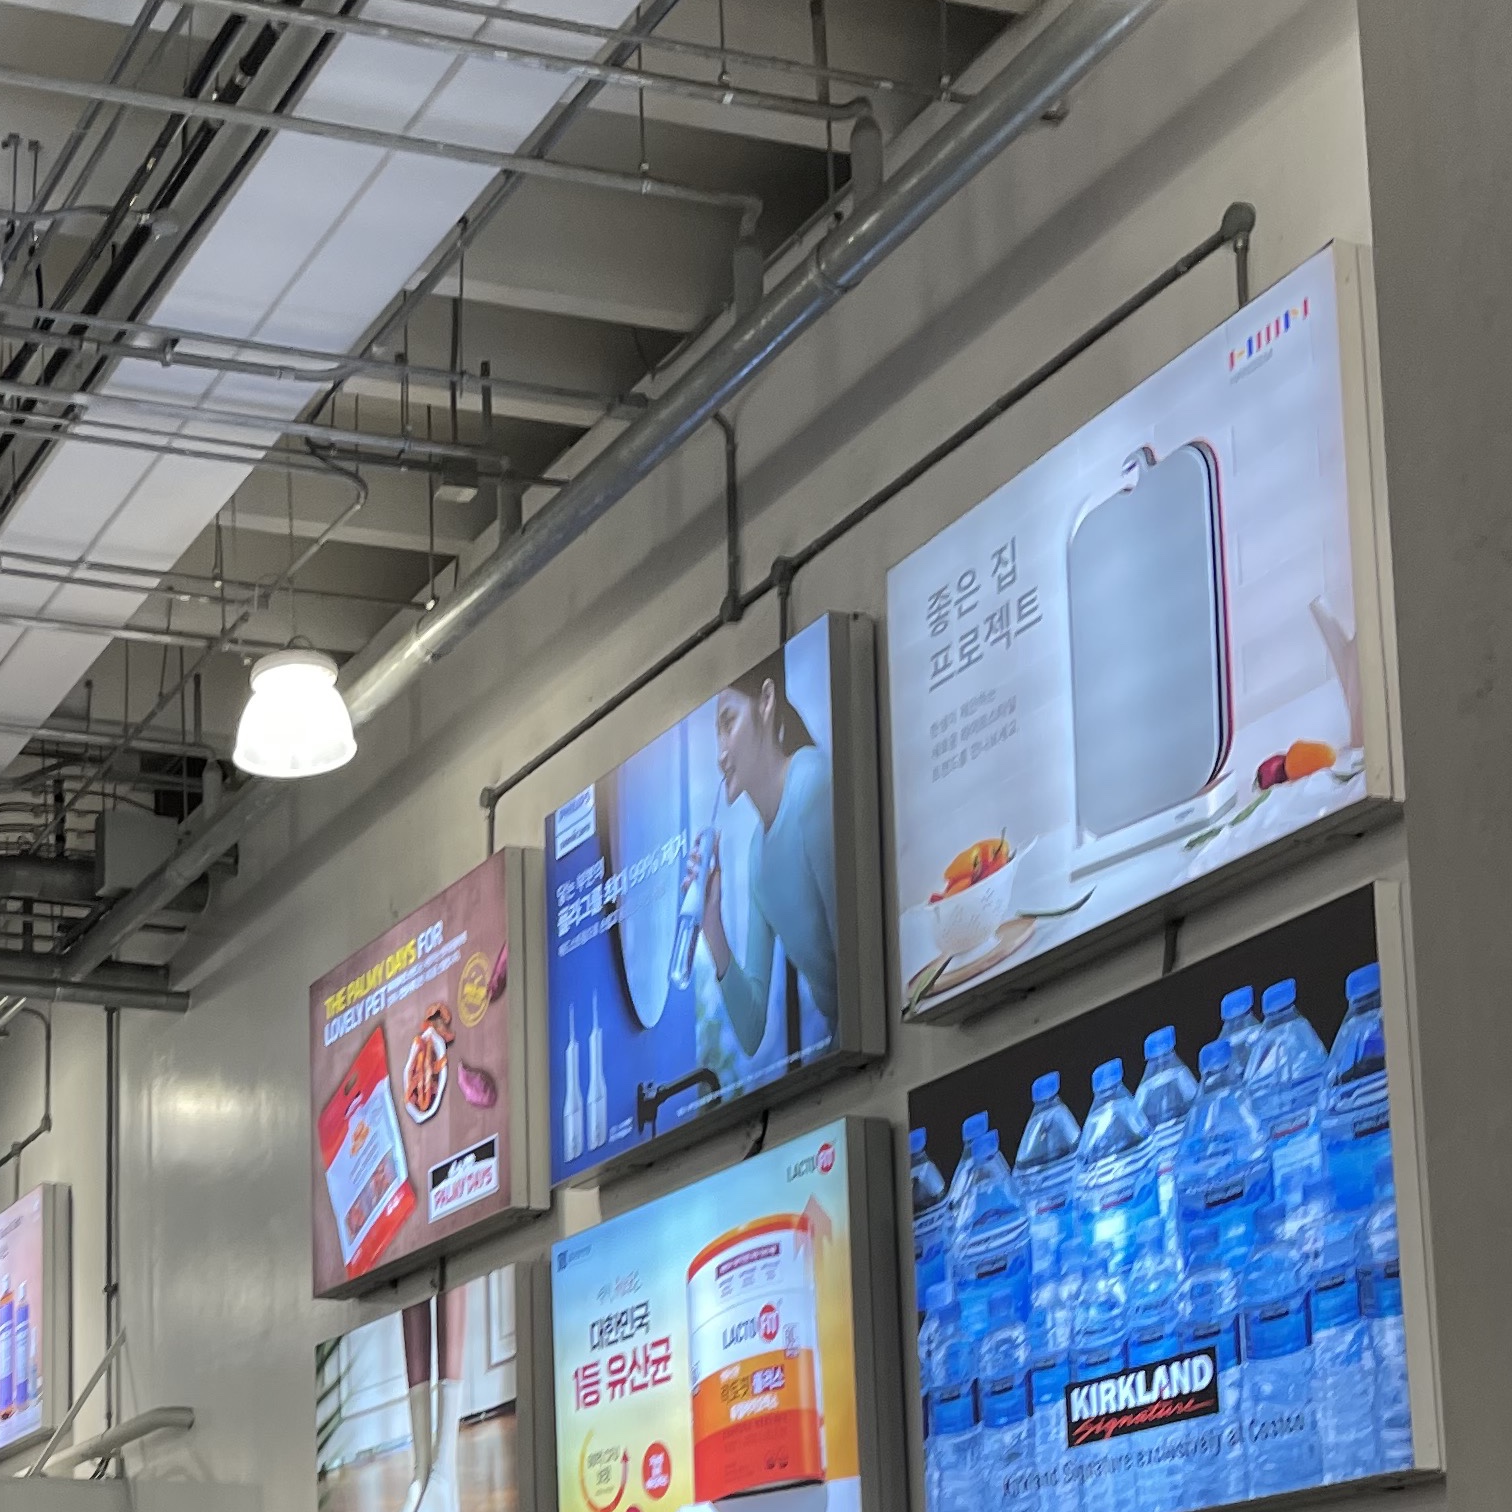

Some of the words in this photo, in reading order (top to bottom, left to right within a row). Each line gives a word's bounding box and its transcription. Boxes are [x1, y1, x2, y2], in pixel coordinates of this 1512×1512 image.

[926, 568, 982, 638] 좋은
[991, 534, 1018, 595] 집
[929, 584, 1043, 694] 프로젝트
[324, 986, 348, 1020] THE
[385, 938, 417, 980] DAYS
[417, 919, 444, 959] FOR
[323, 999, 366, 1047] LOVELY
[364, 985, 388, 1021] PET
[589, 1299, 650, 1351] 대한민국
[574, 1359, 601, 1412] 1등
[607, 1334, 672, 1402] 유산균
[1071, 1353, 1215, 1423] KIRKLAND
[1072, 1398, 1215, 1446] Signature
